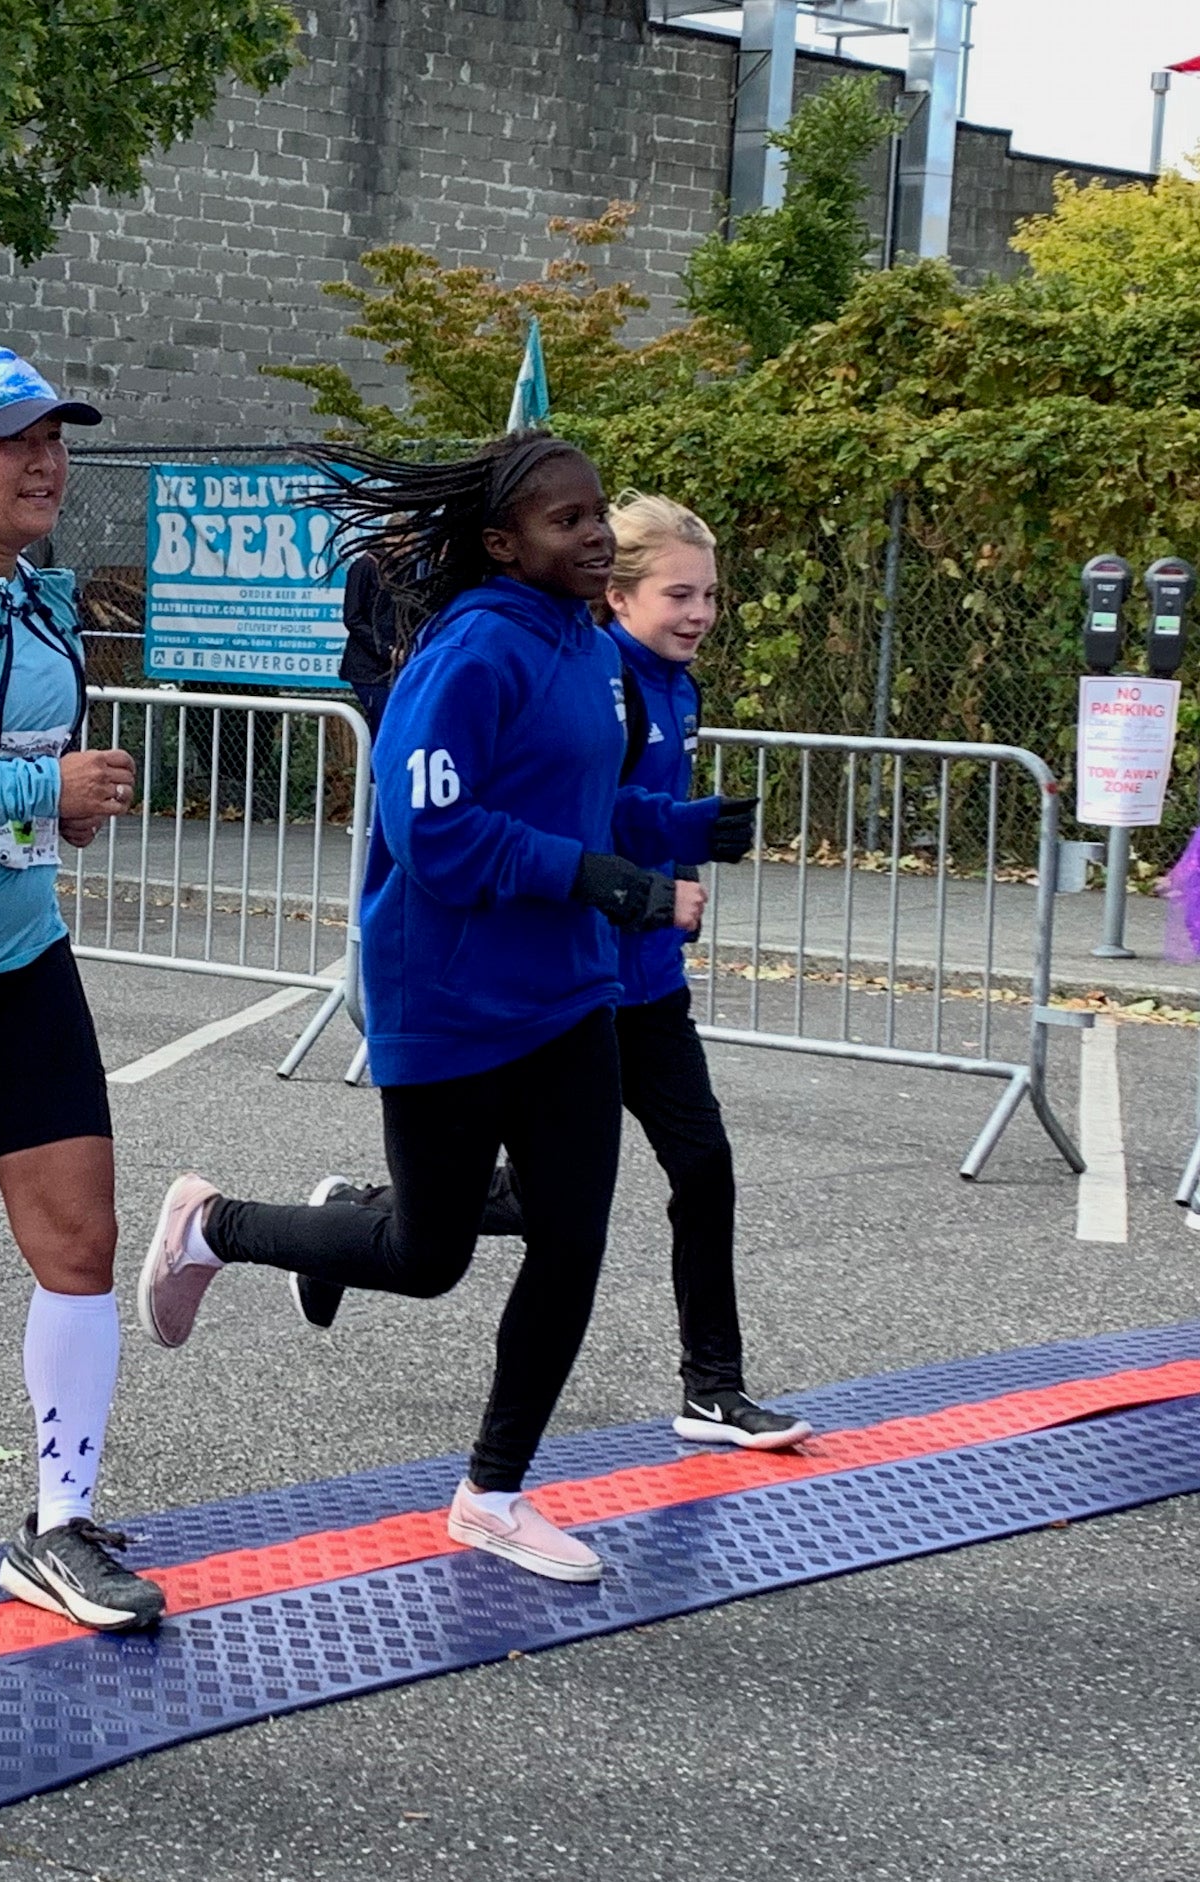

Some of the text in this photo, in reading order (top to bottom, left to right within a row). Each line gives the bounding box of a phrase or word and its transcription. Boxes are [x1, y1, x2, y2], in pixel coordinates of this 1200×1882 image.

[156, 475, 197, 508] WE
[152, 513, 330, 580] BEER!
[240, 589, 313, 600] ORDER BEER AT
[237, 622, 313, 634] DELIVERY HOURS
[1116, 687, 1141, 701] NO
[1091, 702, 1166, 718] PARKING
[406, 748, 461, 809] 16
[1087, 766, 1161, 780] TOW AWAY
[1103, 780, 1143, 794] ZONE
